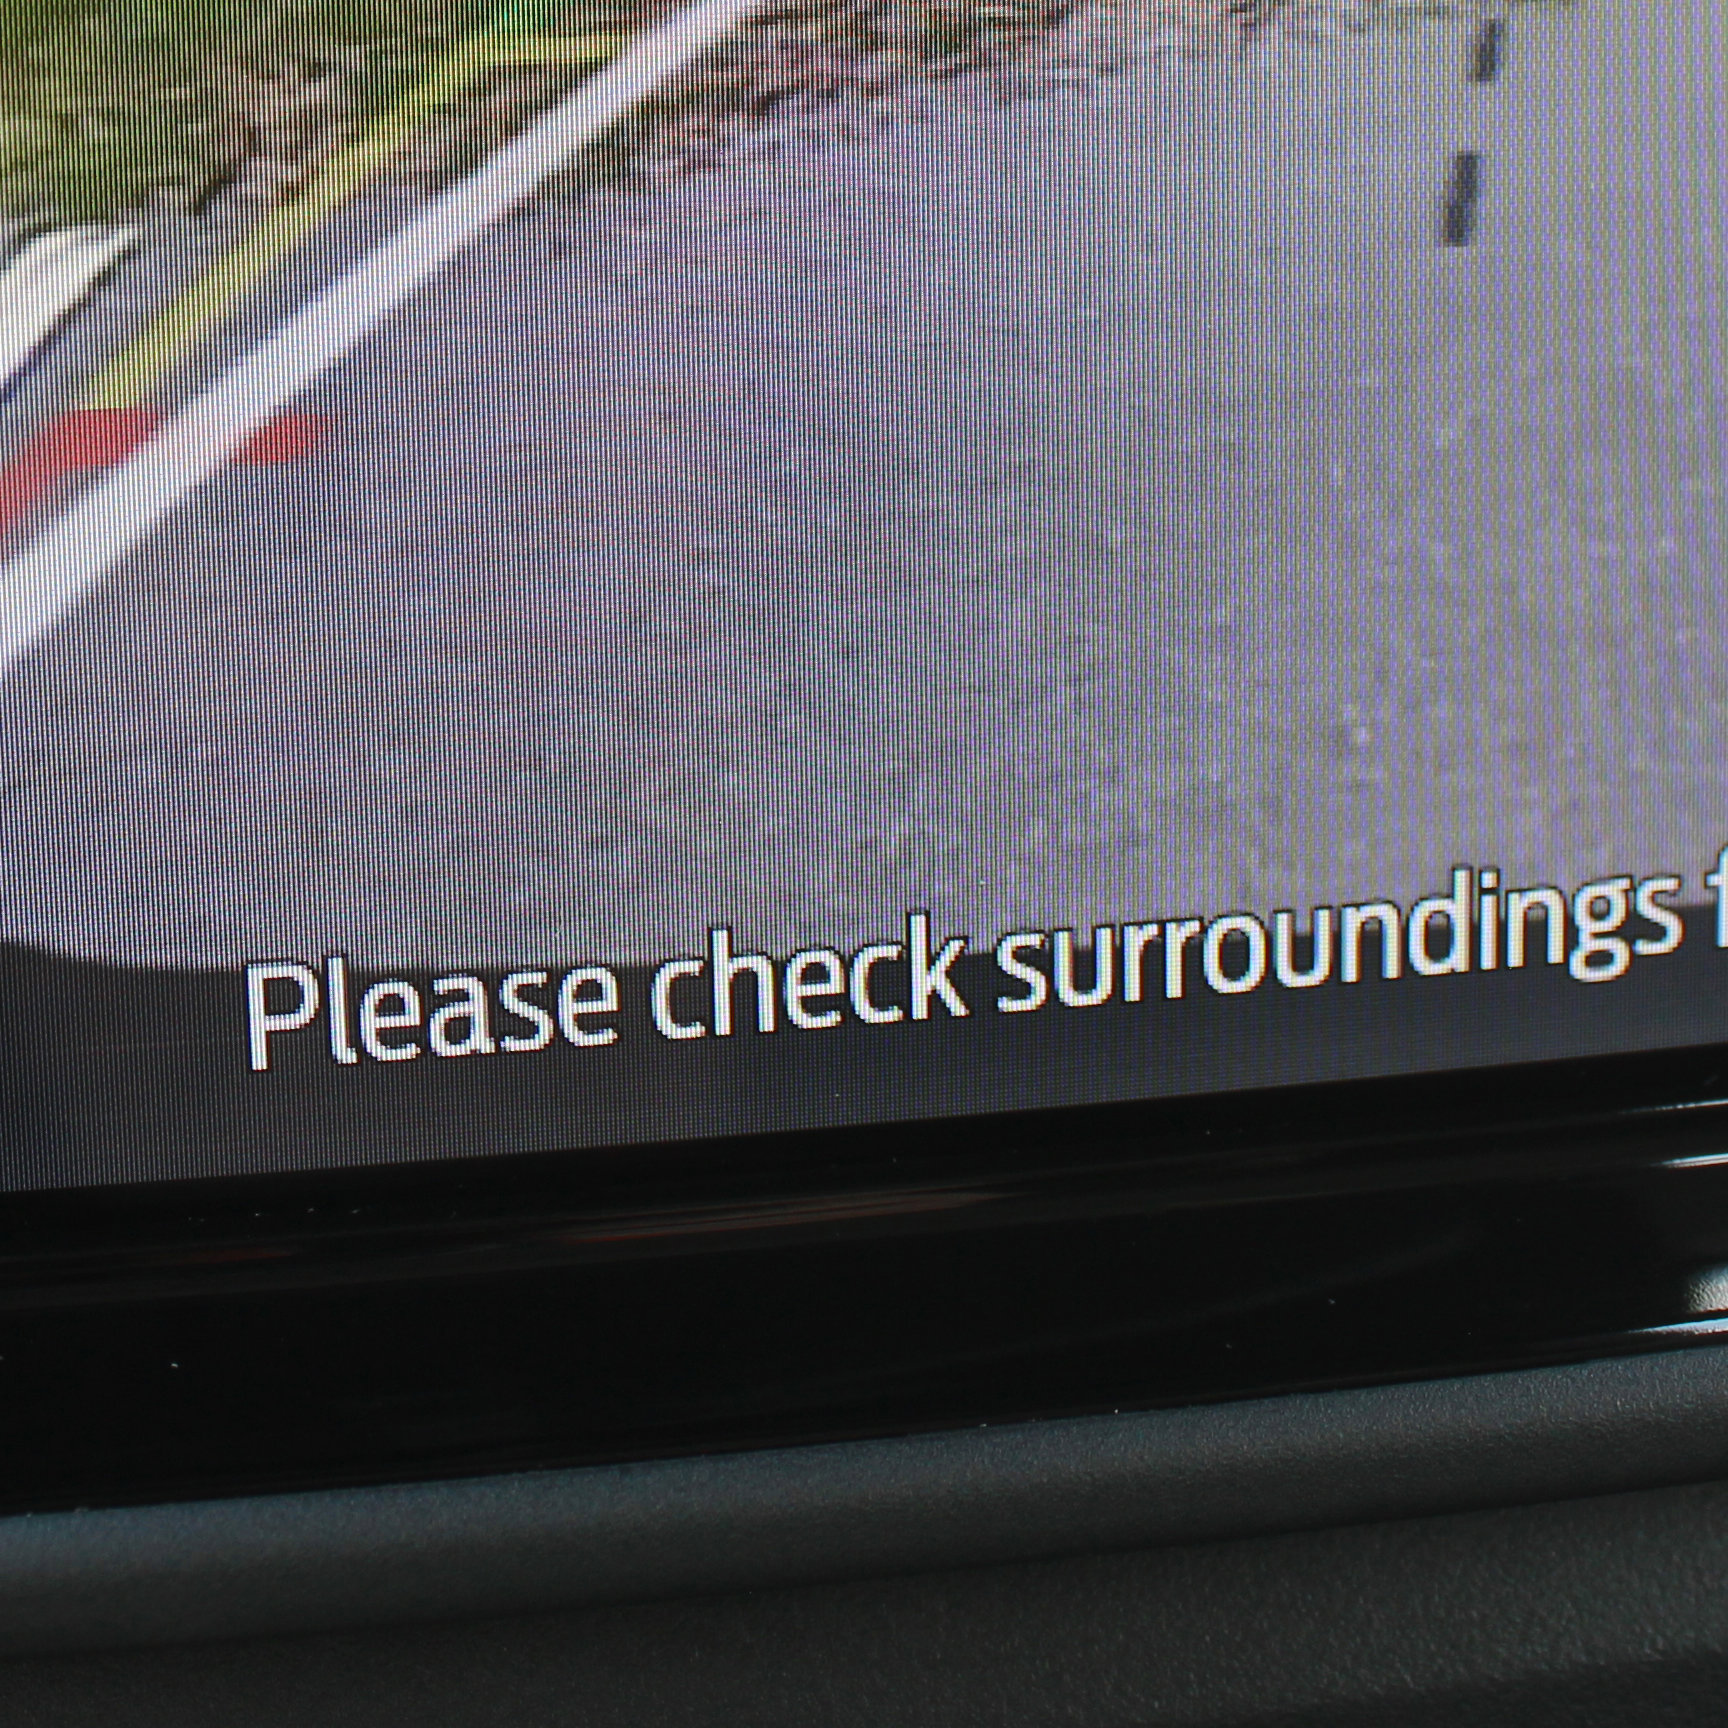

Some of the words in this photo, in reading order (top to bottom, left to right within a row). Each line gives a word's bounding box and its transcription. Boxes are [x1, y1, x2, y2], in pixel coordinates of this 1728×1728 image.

[244, 957, 621, 1073] Please
[648, 913, 972, 1041] check
[993, 867, 1684, 1015] surroundings
